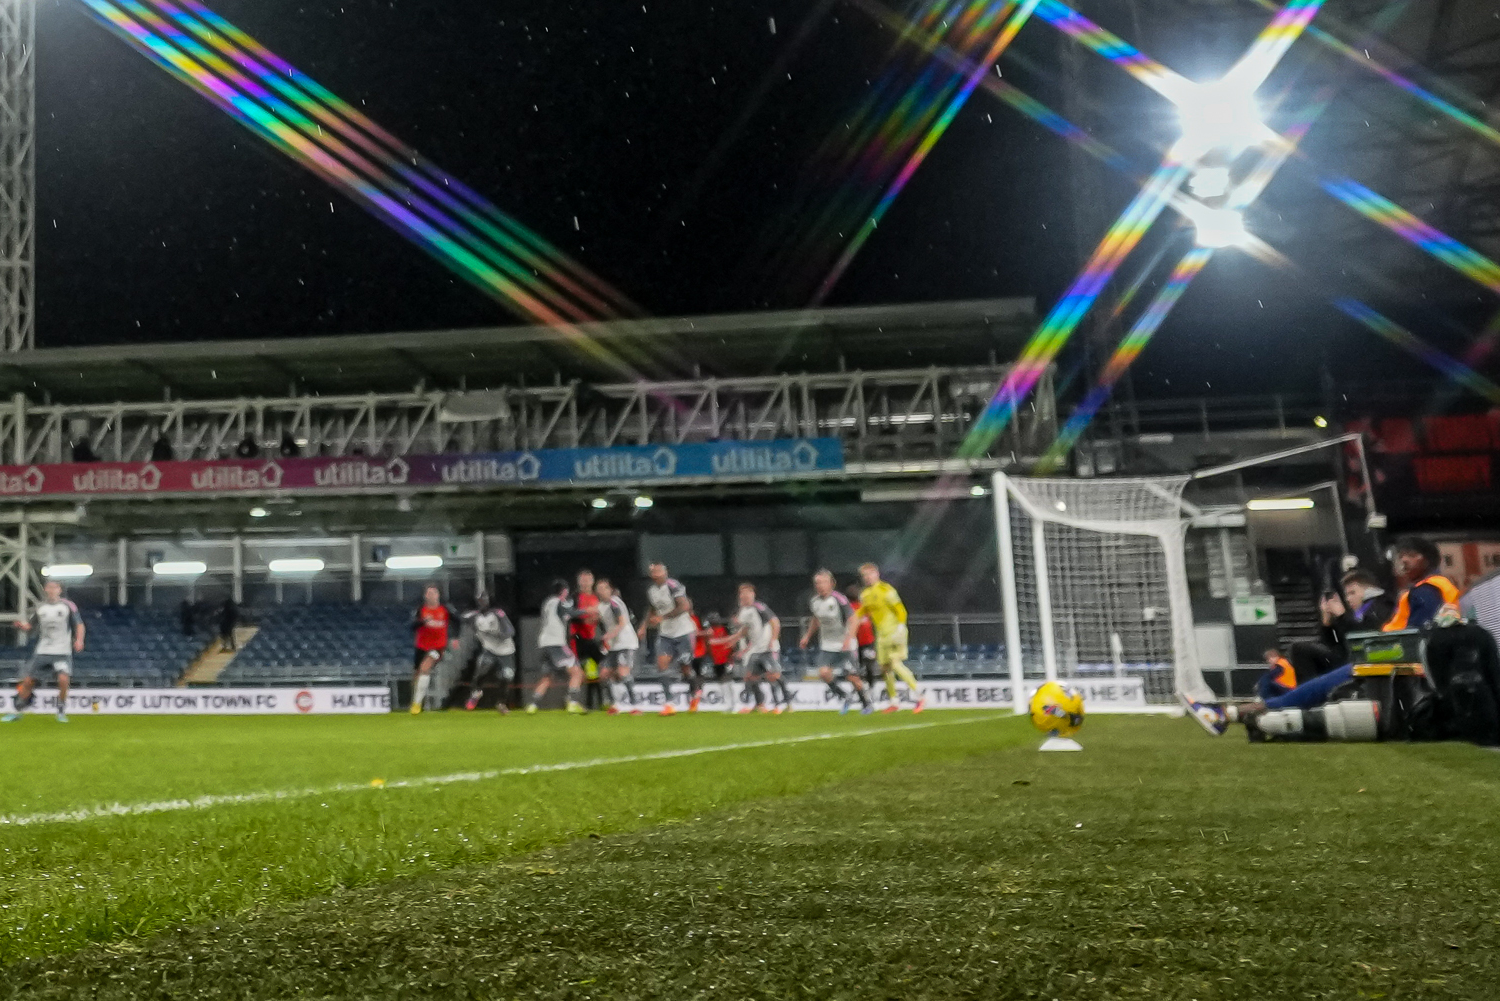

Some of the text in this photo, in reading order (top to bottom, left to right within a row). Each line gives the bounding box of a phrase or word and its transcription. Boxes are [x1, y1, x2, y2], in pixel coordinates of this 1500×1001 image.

[42, 694, 111, 709] HITORY
[115, 694, 136, 709] OF
[142, 694, 198, 709] LUTON
[202, 693, 253, 709] TOWN
[256, 693, 278, 709] FC
[933, 687, 971, 703] THE
